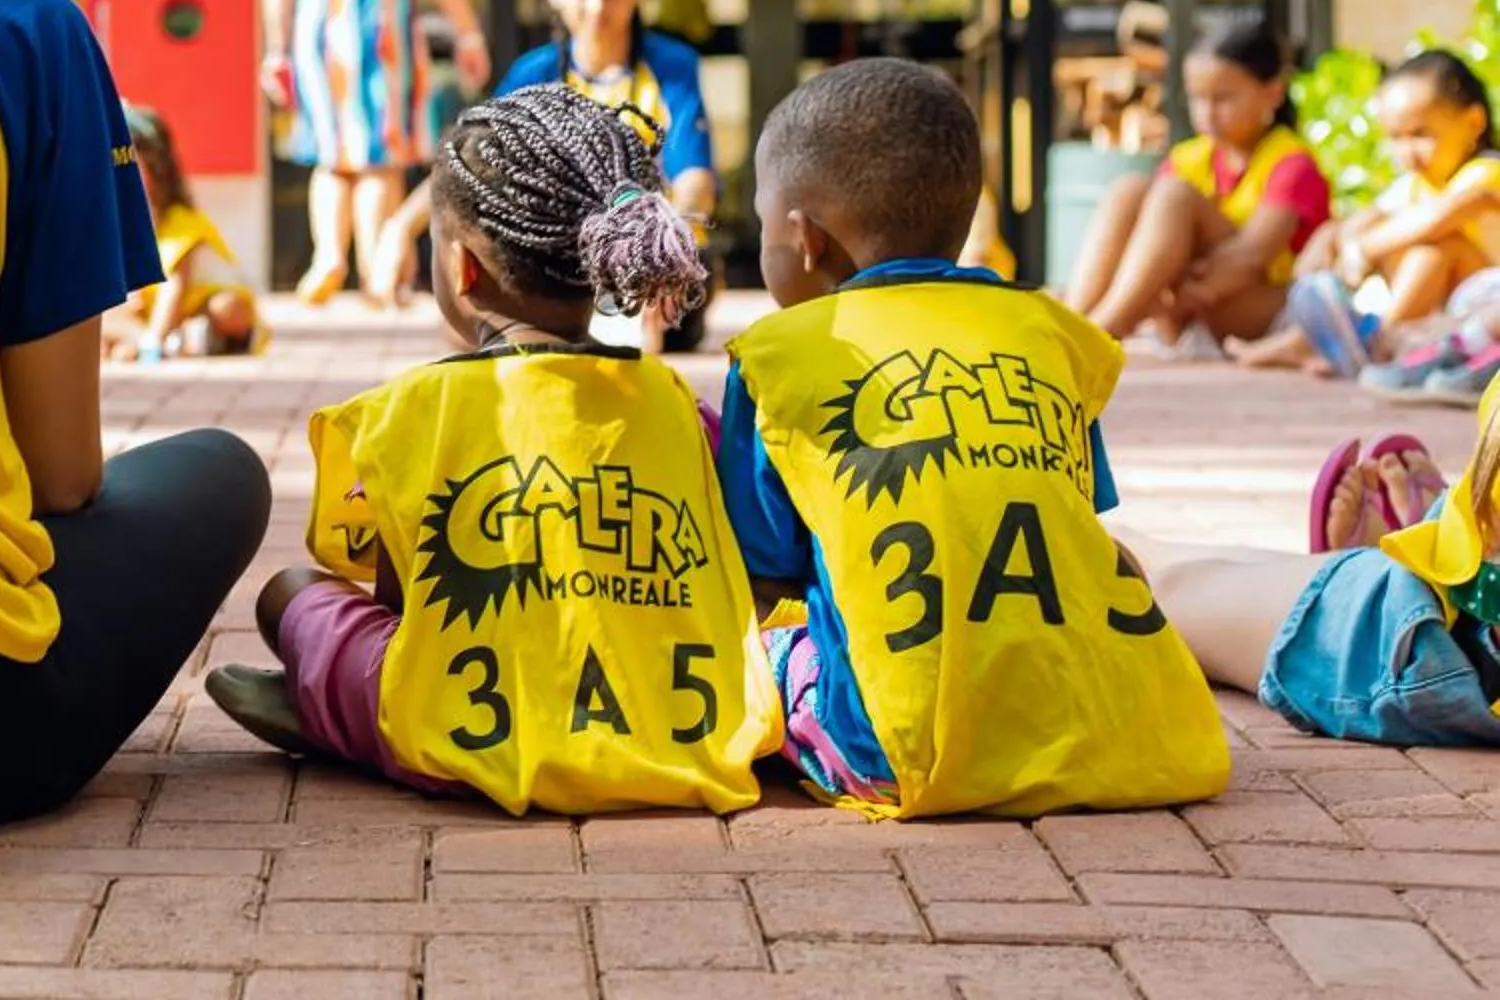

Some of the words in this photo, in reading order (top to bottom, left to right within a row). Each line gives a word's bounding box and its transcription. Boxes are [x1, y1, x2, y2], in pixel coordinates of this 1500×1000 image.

[446, 454, 709, 579] GALERA
[545, 569, 693, 608] MONREALE
[869, 521, 944, 654] 3
[966, 501, 1066, 626] A
[446, 645, 513, 752] 3
[570, 643, 631, 735] A
[670, 643, 718, 745] 5
